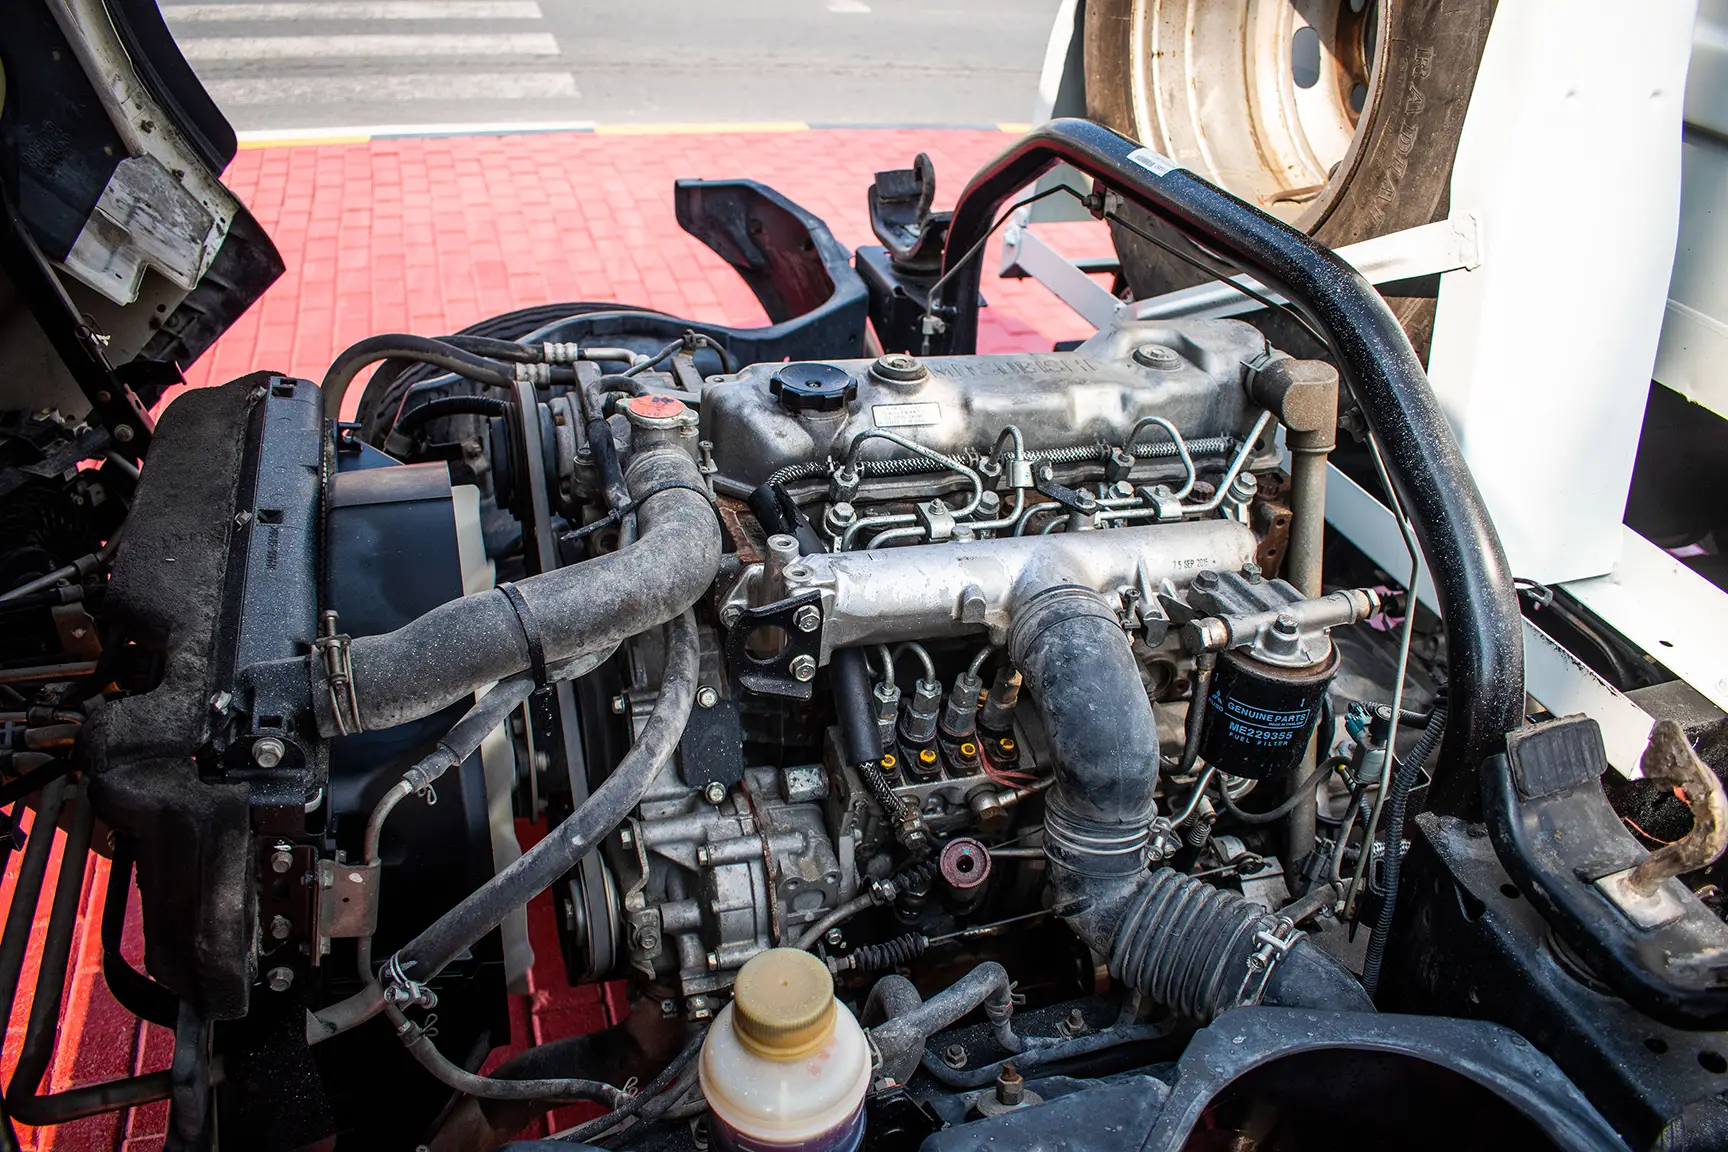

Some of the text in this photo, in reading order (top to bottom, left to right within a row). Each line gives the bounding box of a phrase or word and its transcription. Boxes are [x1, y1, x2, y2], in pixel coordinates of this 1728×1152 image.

[1183, 559, 1195, 569] SEP
[1207, 697, 1224, 712] FUSO
[1227, 702, 1306, 723] GENUINE PARTS
[1228, 732, 1250, 744] FUEL
[1229, 721, 1293, 740] ME229355
